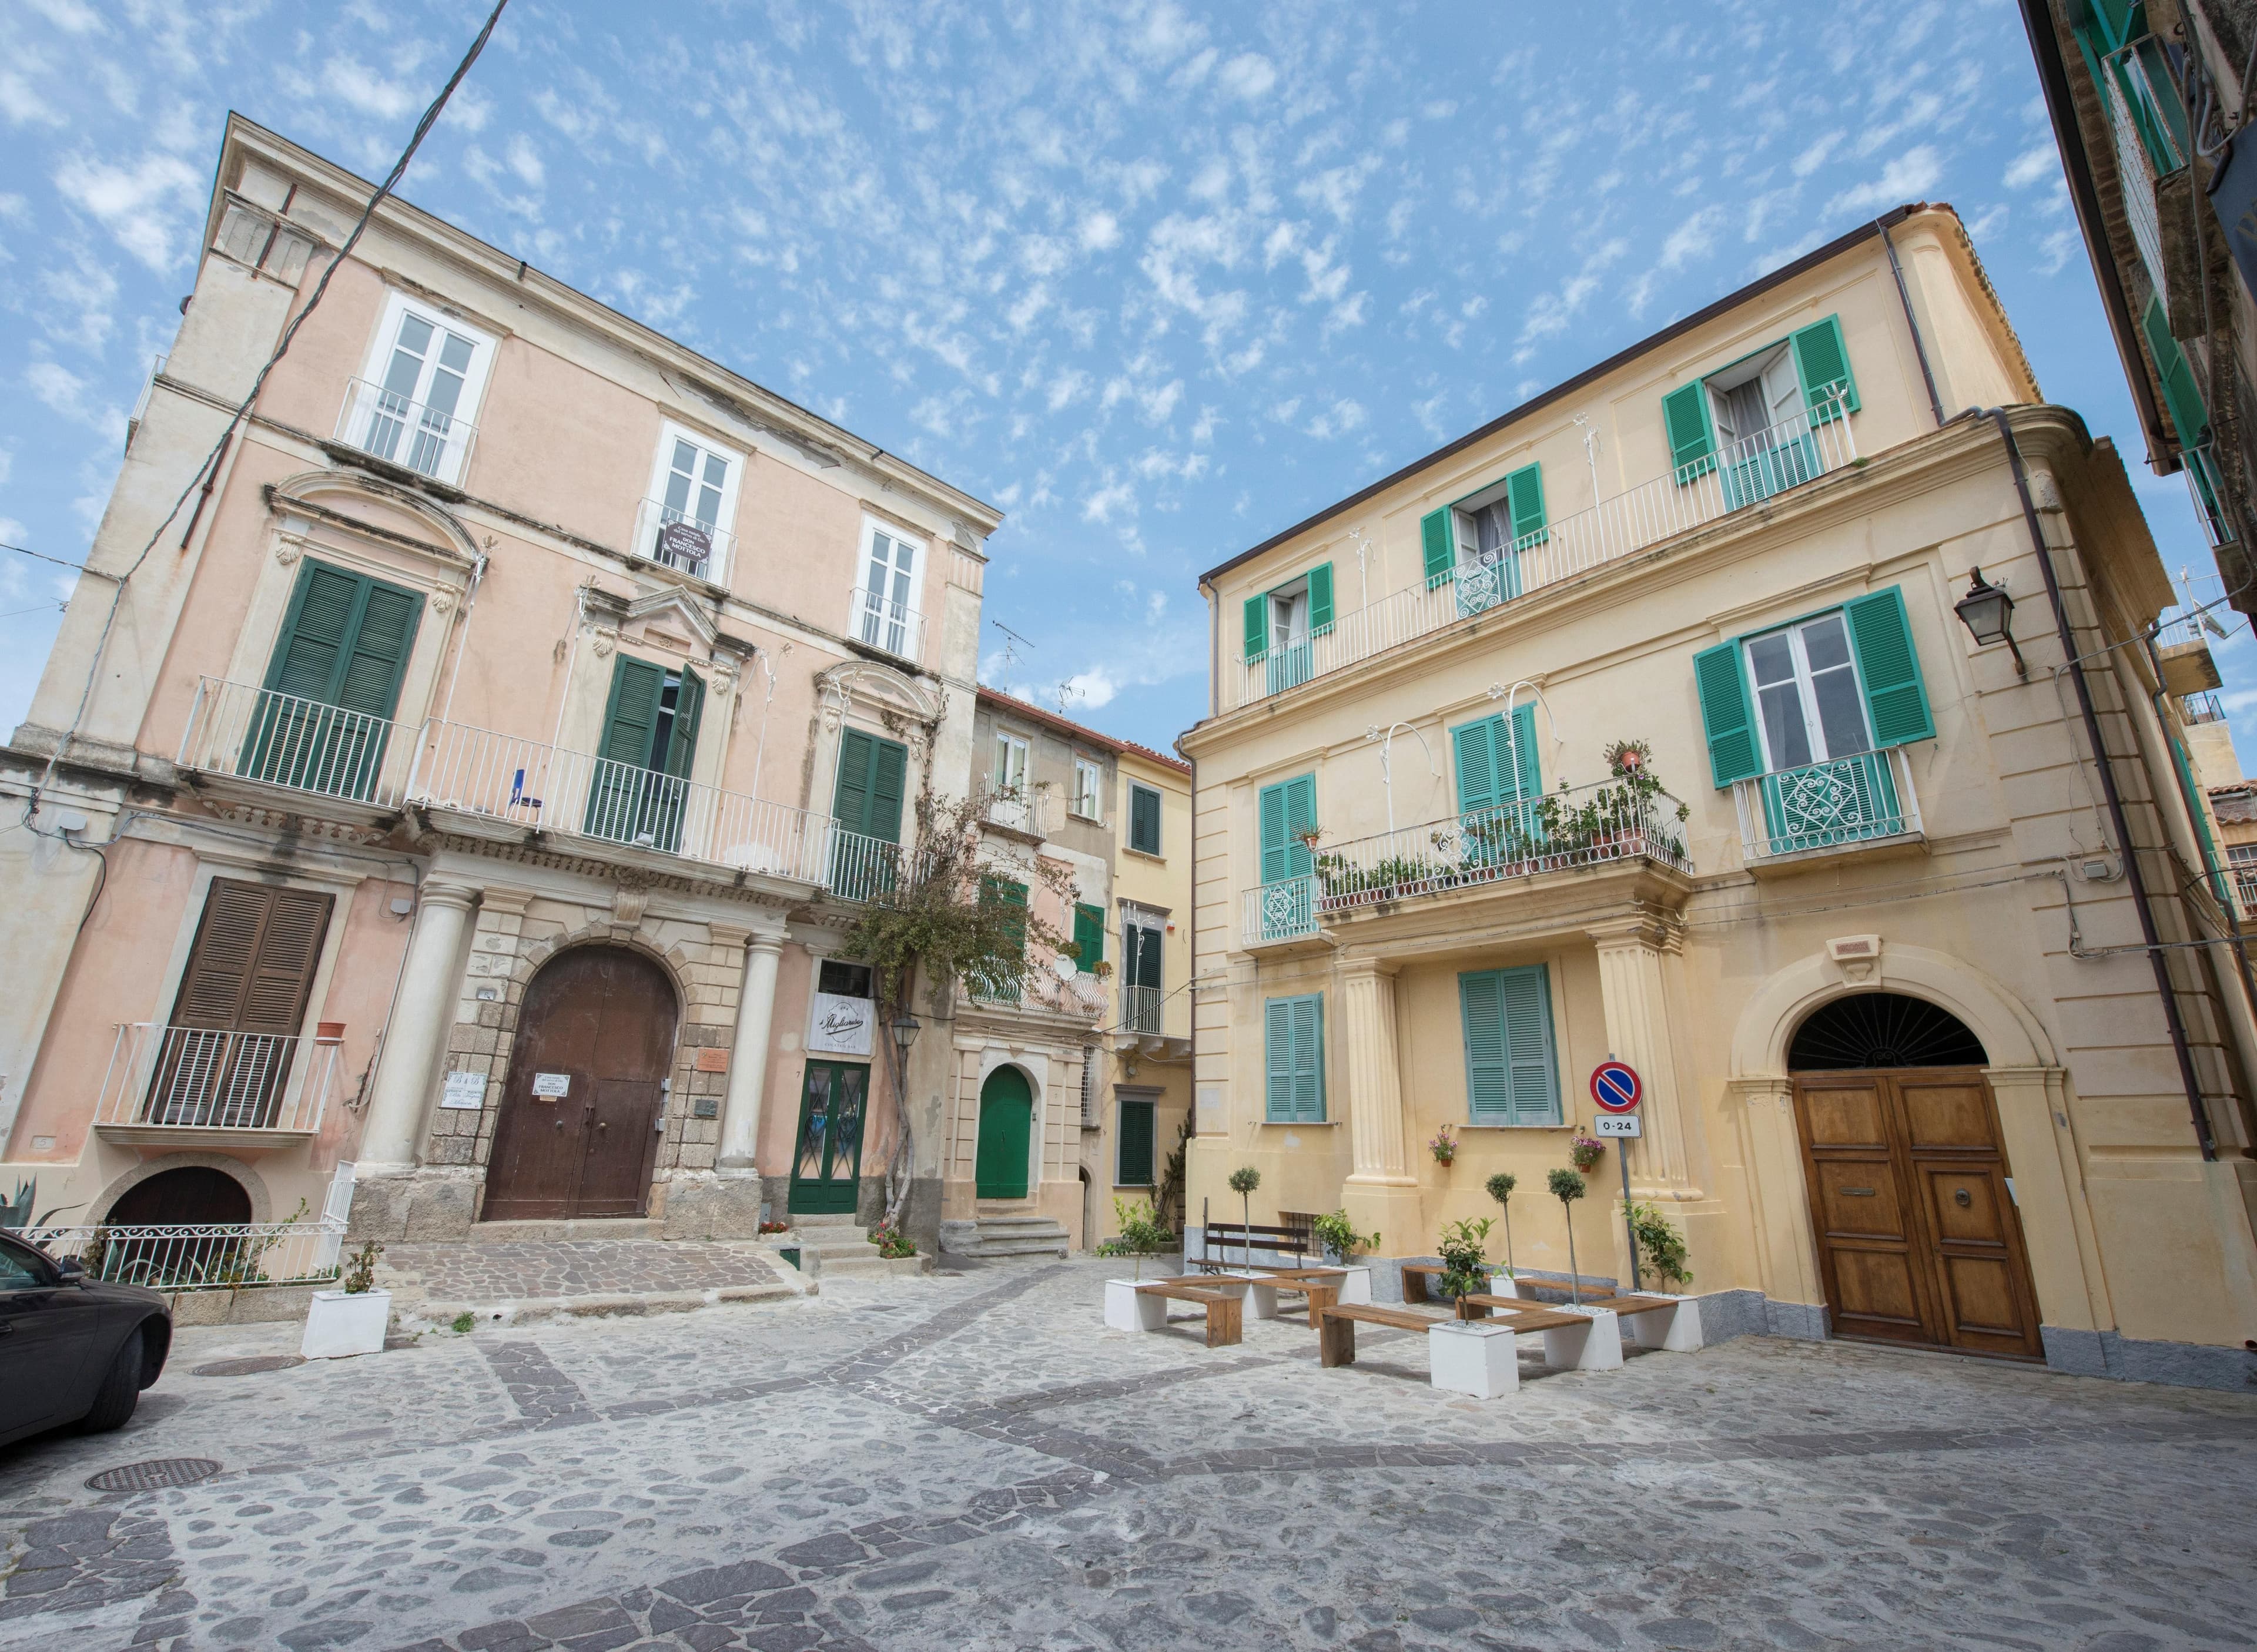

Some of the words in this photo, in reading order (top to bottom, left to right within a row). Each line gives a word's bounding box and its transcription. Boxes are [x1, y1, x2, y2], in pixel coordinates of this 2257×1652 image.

[689, 530, 701, 538] natale
[669, 537, 705, 554] FRANCESCO
[672, 543, 701, 558] MOTTOLA
